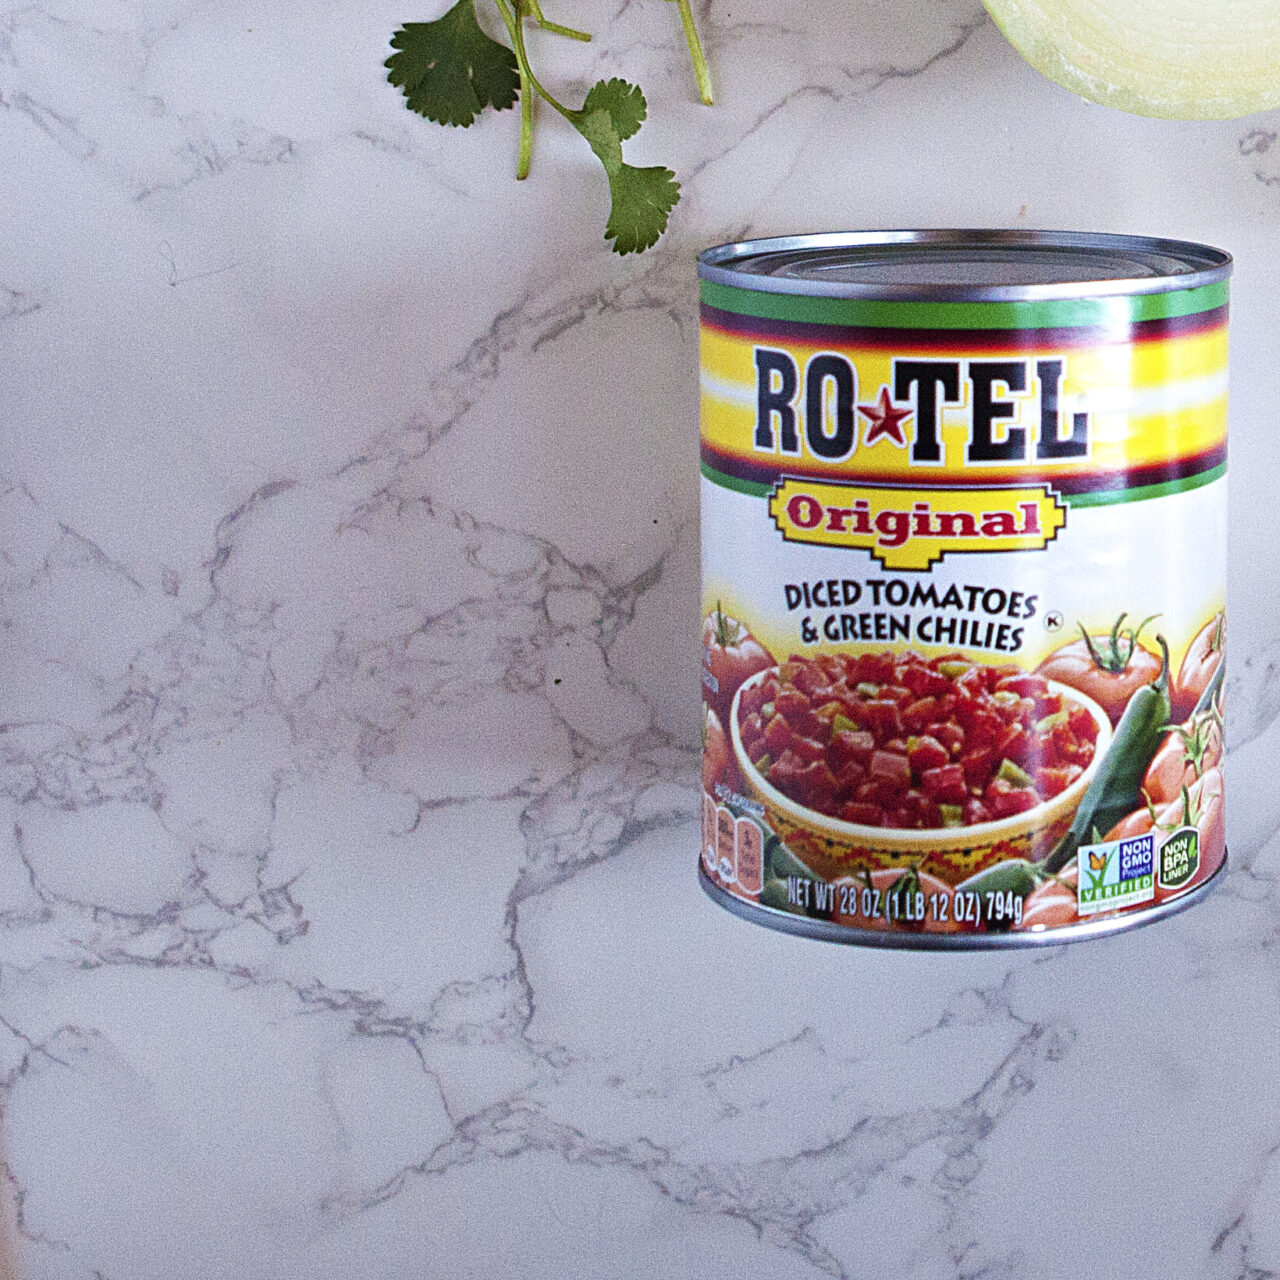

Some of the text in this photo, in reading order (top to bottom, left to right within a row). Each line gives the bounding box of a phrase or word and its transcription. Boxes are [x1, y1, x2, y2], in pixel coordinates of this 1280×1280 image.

[786, 494, 1041, 546] Original
[785, 580, 1039, 619] DICED TOMATOES
[802, 613, 1025, 652] & GREEN CHILIES
[1122, 838, 1151, 857] NON
[1165, 838, 1188, 857] NON
[1122, 852, 1152, 869] GMO
[1163, 851, 1189, 872] BPA
[1122, 865, 1151, 879] Project
[1163, 864, 1189, 882] LINER
[1084, 878, 1151, 901] VERIFIED
[788, 876, 1023, 927] NET WT 28 OZ (1 LB 12 OZ) 794g
